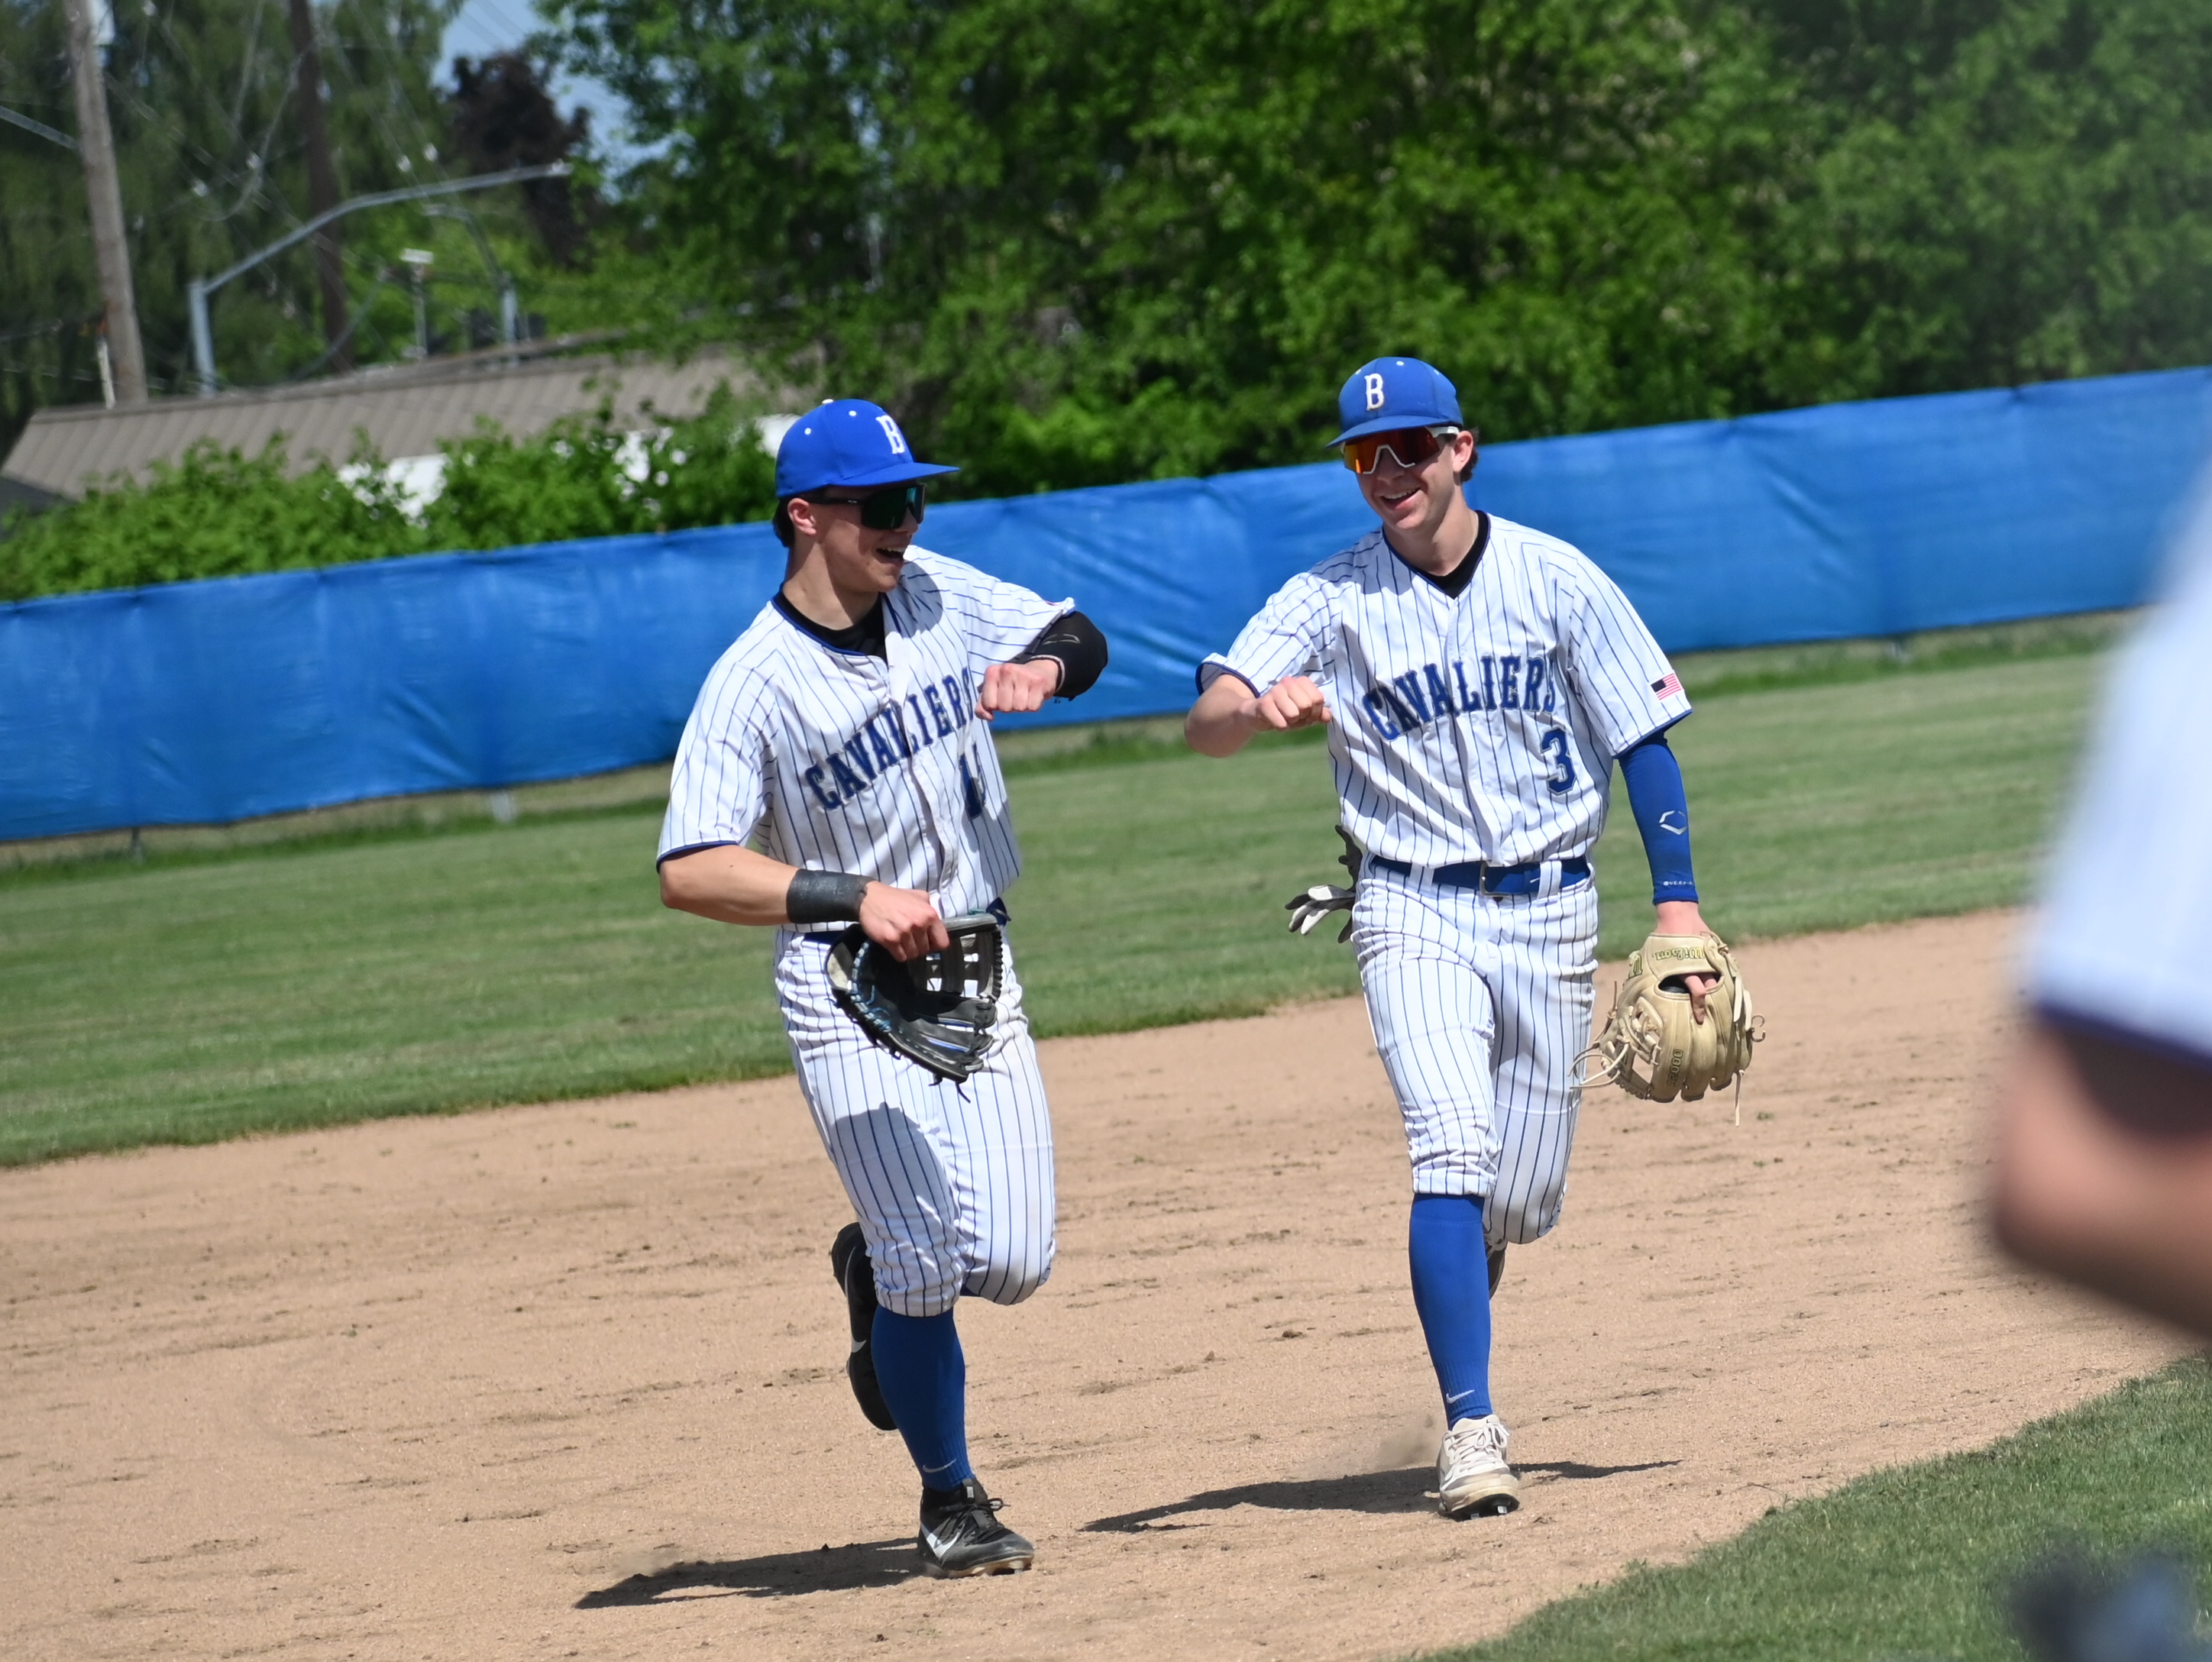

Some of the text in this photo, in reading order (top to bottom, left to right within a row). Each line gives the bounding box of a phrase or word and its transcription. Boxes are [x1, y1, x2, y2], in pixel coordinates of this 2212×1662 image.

[1364, 373, 1385, 412] B
[875, 415, 906, 454] B
[1362, 655, 1557, 741] CAVALIERS
[1540, 726, 1577, 797] 3
